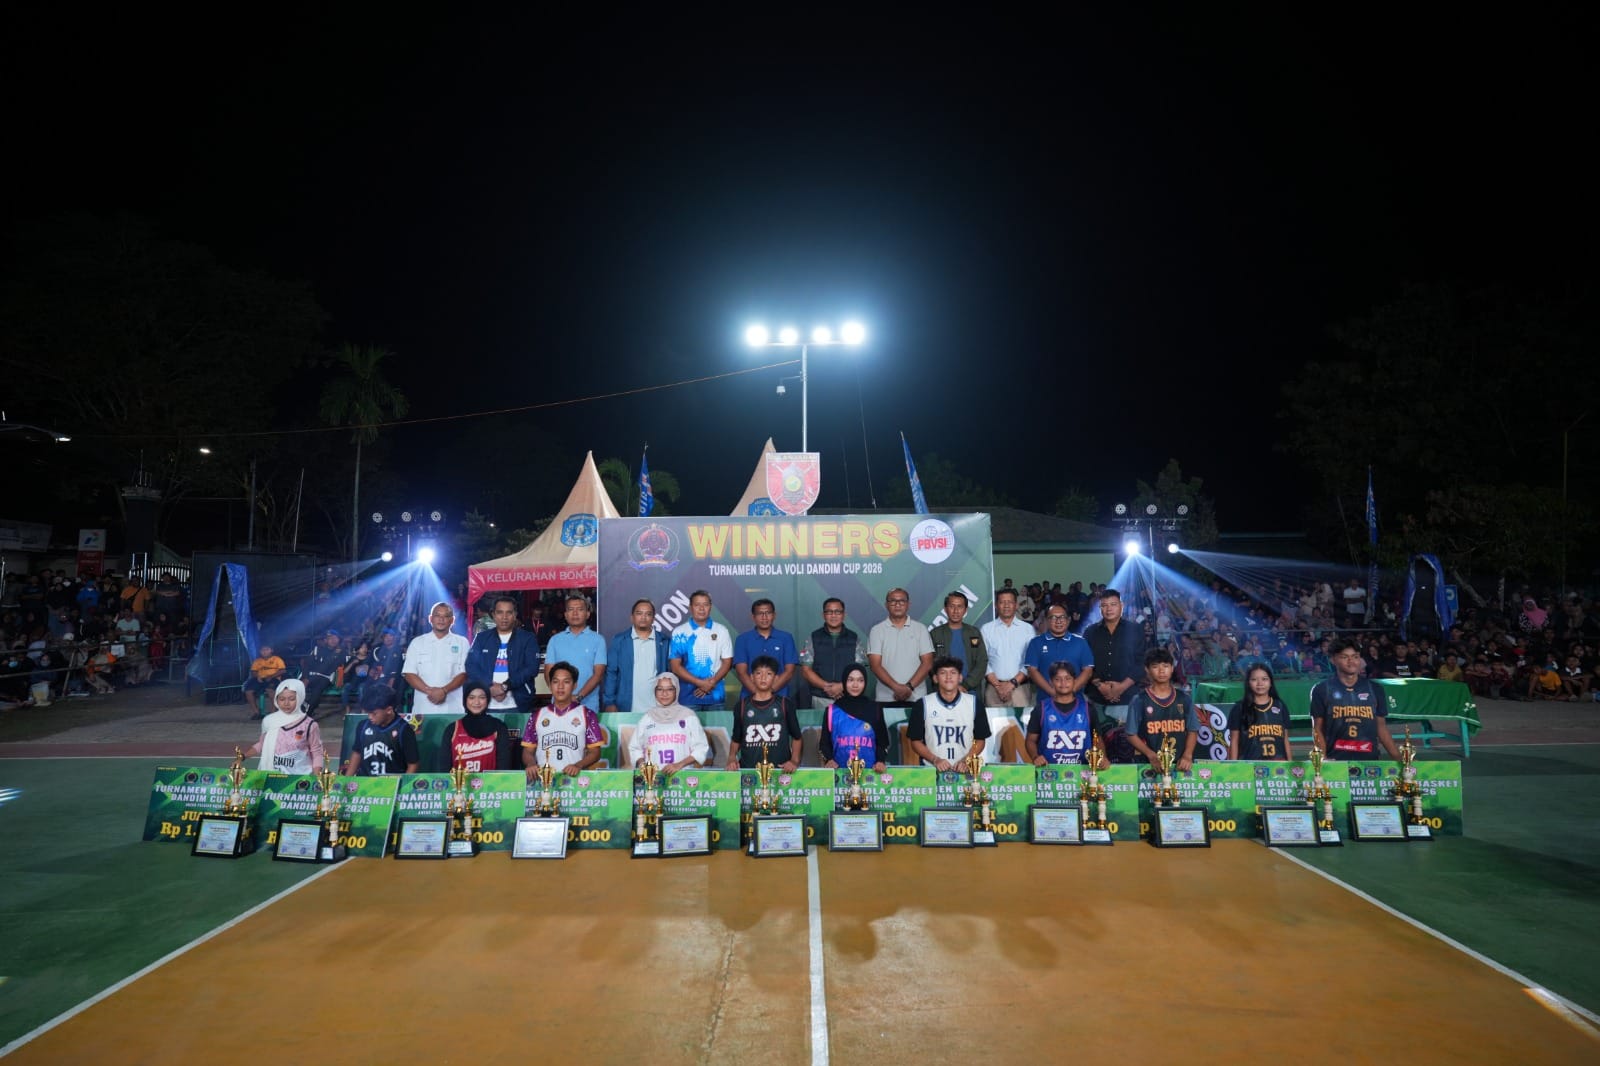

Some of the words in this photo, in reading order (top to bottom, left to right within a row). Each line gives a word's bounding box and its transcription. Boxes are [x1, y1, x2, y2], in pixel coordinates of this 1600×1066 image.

[687, 522, 903, 559] WINNERS
[917, 536, 947, 550] PBVSI
[709, 564, 757, 576] TURNAMEN
[759, 564, 782, 575] BOLA
[785, 563, 804, 575] VOLI
[806, 563, 841, 575] DANDIM
[843, 563, 860, 574] CUP
[863, 562, 882, 574] 2026
[487, 571, 557, 583] KELURAHAN
[1332, 705, 1374, 720] SMANSA
[933, 725, 967, 748] YPK
[1348, 724, 1358, 738] 6
[557, 748, 563, 760] 8
[1262, 743, 1276, 757] 13
[658, 749, 674, 764] 19
[370, 761, 386, 775] 31
[466, 760, 481, 772] 20
[155, 784, 207, 795] TURNAMEN
[990, 785, 1034, 793] BASKET
[1176, 782, 1205, 790] BOLA
[1209, 782, 1252, 790] BASKET
[1267, 780, 1298, 788] BOLA
[479, 791, 523, 800] BASKET
[552, 790, 582, 799] BOLA
[586, 790, 630, 799] BASKET
[662, 789, 691, 798] BOLA
[695, 791, 738, 800] BASKET
[788, 788, 831, 796] BASKET
[890, 787, 933, 795] BASKET
[1203, 790, 1231, 798] 2026
[1270, 788, 1293, 796] CUP
[171, 793, 207, 803] DANDIM
[264, 792, 318, 802] TURNAMEN
[351, 796, 392, 806] BASKET
[580, 799, 608, 807] 2026
[664, 798, 686, 807] CUP
[689, 799, 716, 807] 2026
[782, 796, 810, 805] 2026
[884, 795, 912, 803] 2026
[344, 805, 370, 813] 2026
[399, 801, 442, 810] DANDIM
[472, 801, 501, 809] 2026
[572, 815, 590, 826] III
[160, 821, 181, 838] Rp
